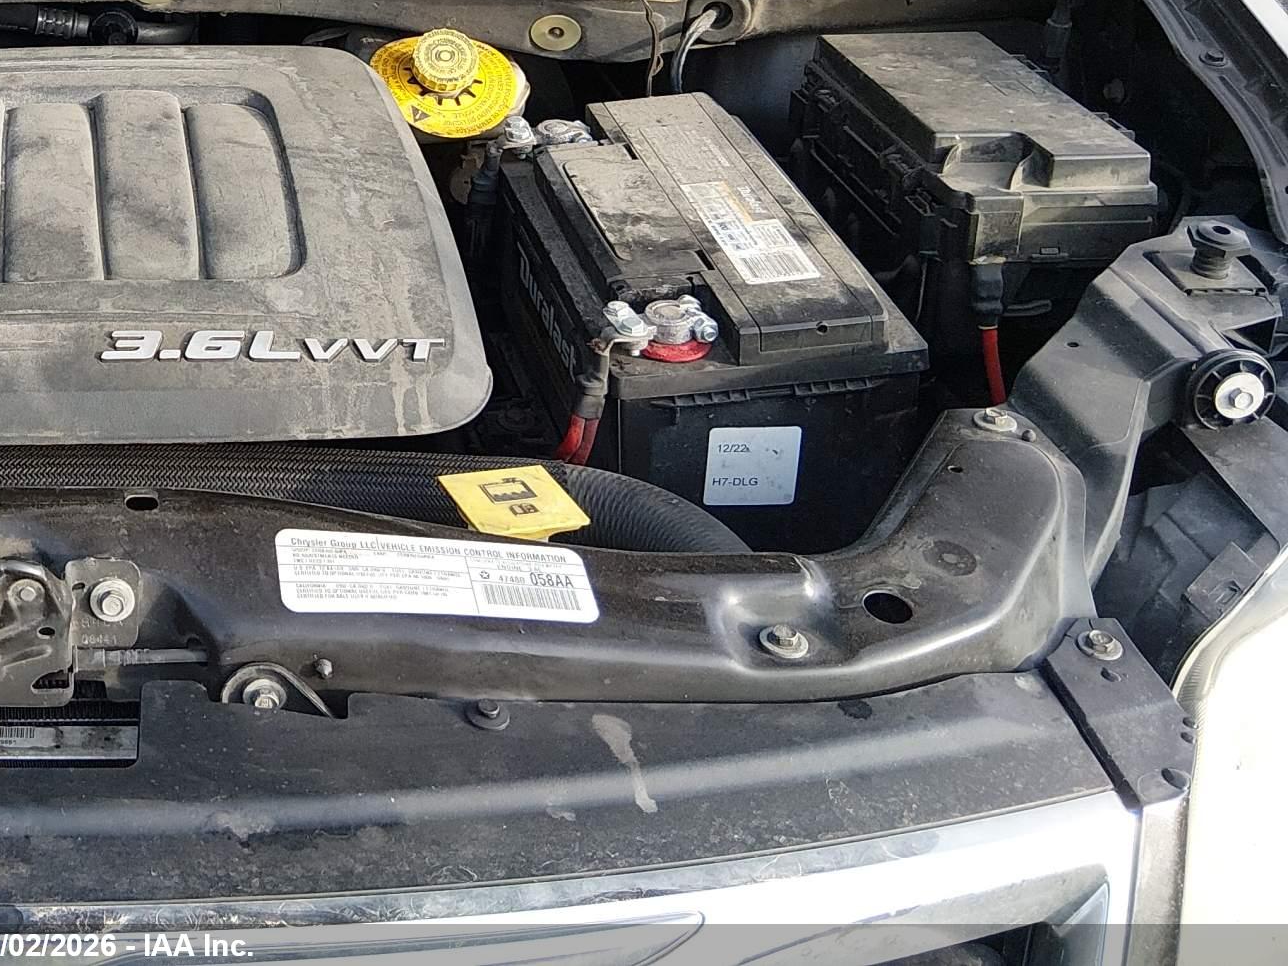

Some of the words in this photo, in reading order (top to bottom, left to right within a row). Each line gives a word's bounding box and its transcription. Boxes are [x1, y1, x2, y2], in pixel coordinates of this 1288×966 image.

[712, 477, 759, 487] H7-DLG
[290, 537, 327, 547] Chrysler
[330, 539, 357, 549] Group
[380, 542, 416, 552] VEHICLE
[419, 544, 461, 555] EMISSION
[464, 548, 503, 559] CONTROL
[506, 552, 567, 563] INFORMATION
[529, 571, 574, 588] 058AA
